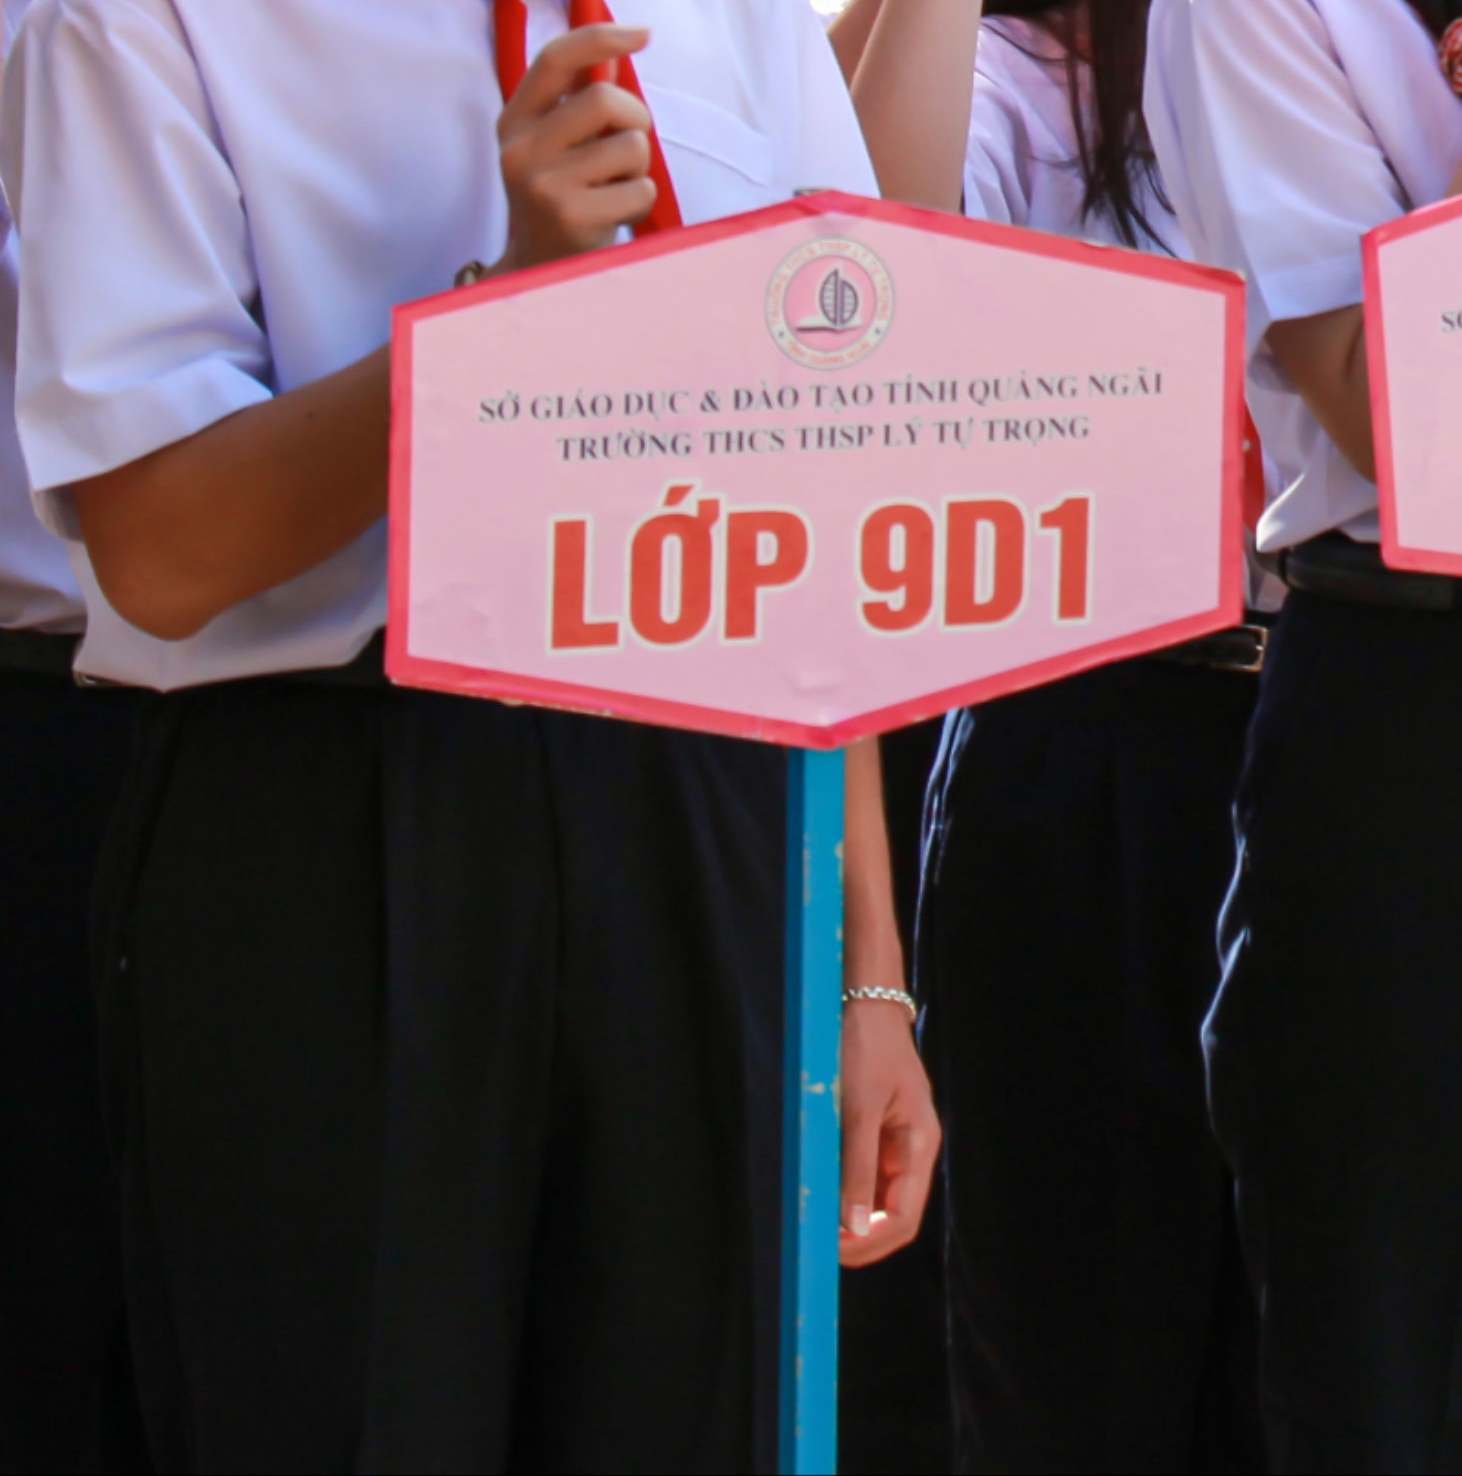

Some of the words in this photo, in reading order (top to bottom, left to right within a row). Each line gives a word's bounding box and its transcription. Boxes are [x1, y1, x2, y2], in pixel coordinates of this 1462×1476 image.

[530, 388, 613, 420] GIÁO
[624, 390, 689, 421] DỤC
[700, 389, 720, 412] &
[810, 383, 874, 413] TẠO
[703, 430, 784, 454] THCS
[795, 424, 874, 452] THSP
[882, 416, 922, 446] LÝ
[984, 416, 1090, 446] TRỌNG
[550, 485, 811, 649] LỚP
[860, 497, 1090, 633] 9D1
